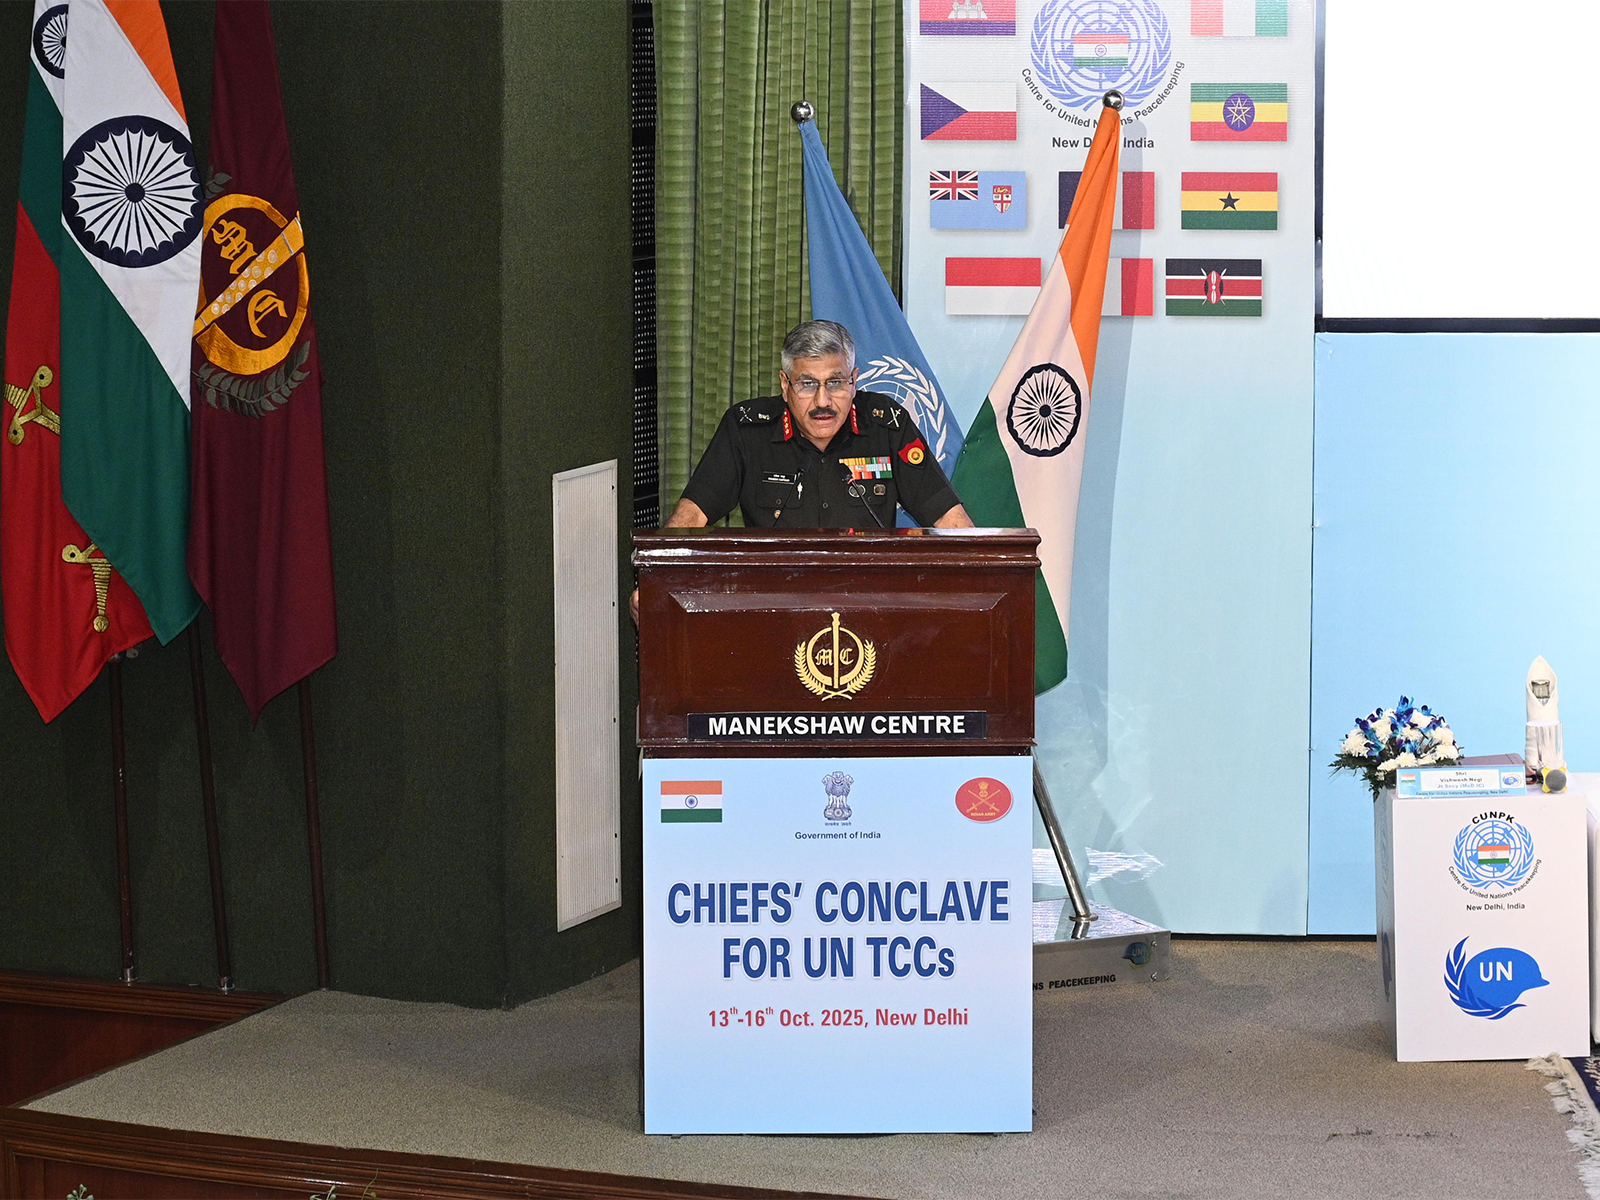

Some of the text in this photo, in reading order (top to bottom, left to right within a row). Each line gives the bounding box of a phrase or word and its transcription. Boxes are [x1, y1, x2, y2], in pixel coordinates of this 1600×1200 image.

[1021, 68, 1043, 101] Centre
[1042, 99, 1057, 113] for
[1057, 109, 1091, 128] United
[1133, 61, 1185, 121] Peacekeeping
[1052, 137, 1079, 148] New
[1123, 136, 1155, 148] India
[708, 714, 966, 736] MANEKSHAW CENTRE
[1472, 811, 1515, 824] CUNPK
[794, 831, 881, 840] Government of India
[1448, 858, 1542, 900] Centre for United Nations Peacekeeping
[815, 880, 1009, 923] CONCLAVE
[1484, 903, 1505, 911] Delhi,
[722, 935, 955, 979] FOR UN TCCs
[1049, 974, 1116, 989] PEACEKEEPING
[1479, 960, 1513, 982] UN
[779, 1009, 815, 1027] Oct.
[820, 1009, 869, 1029] 2025,
[875, 1008, 917, 1026] New
[923, 1007, 968, 1026] Delhi
